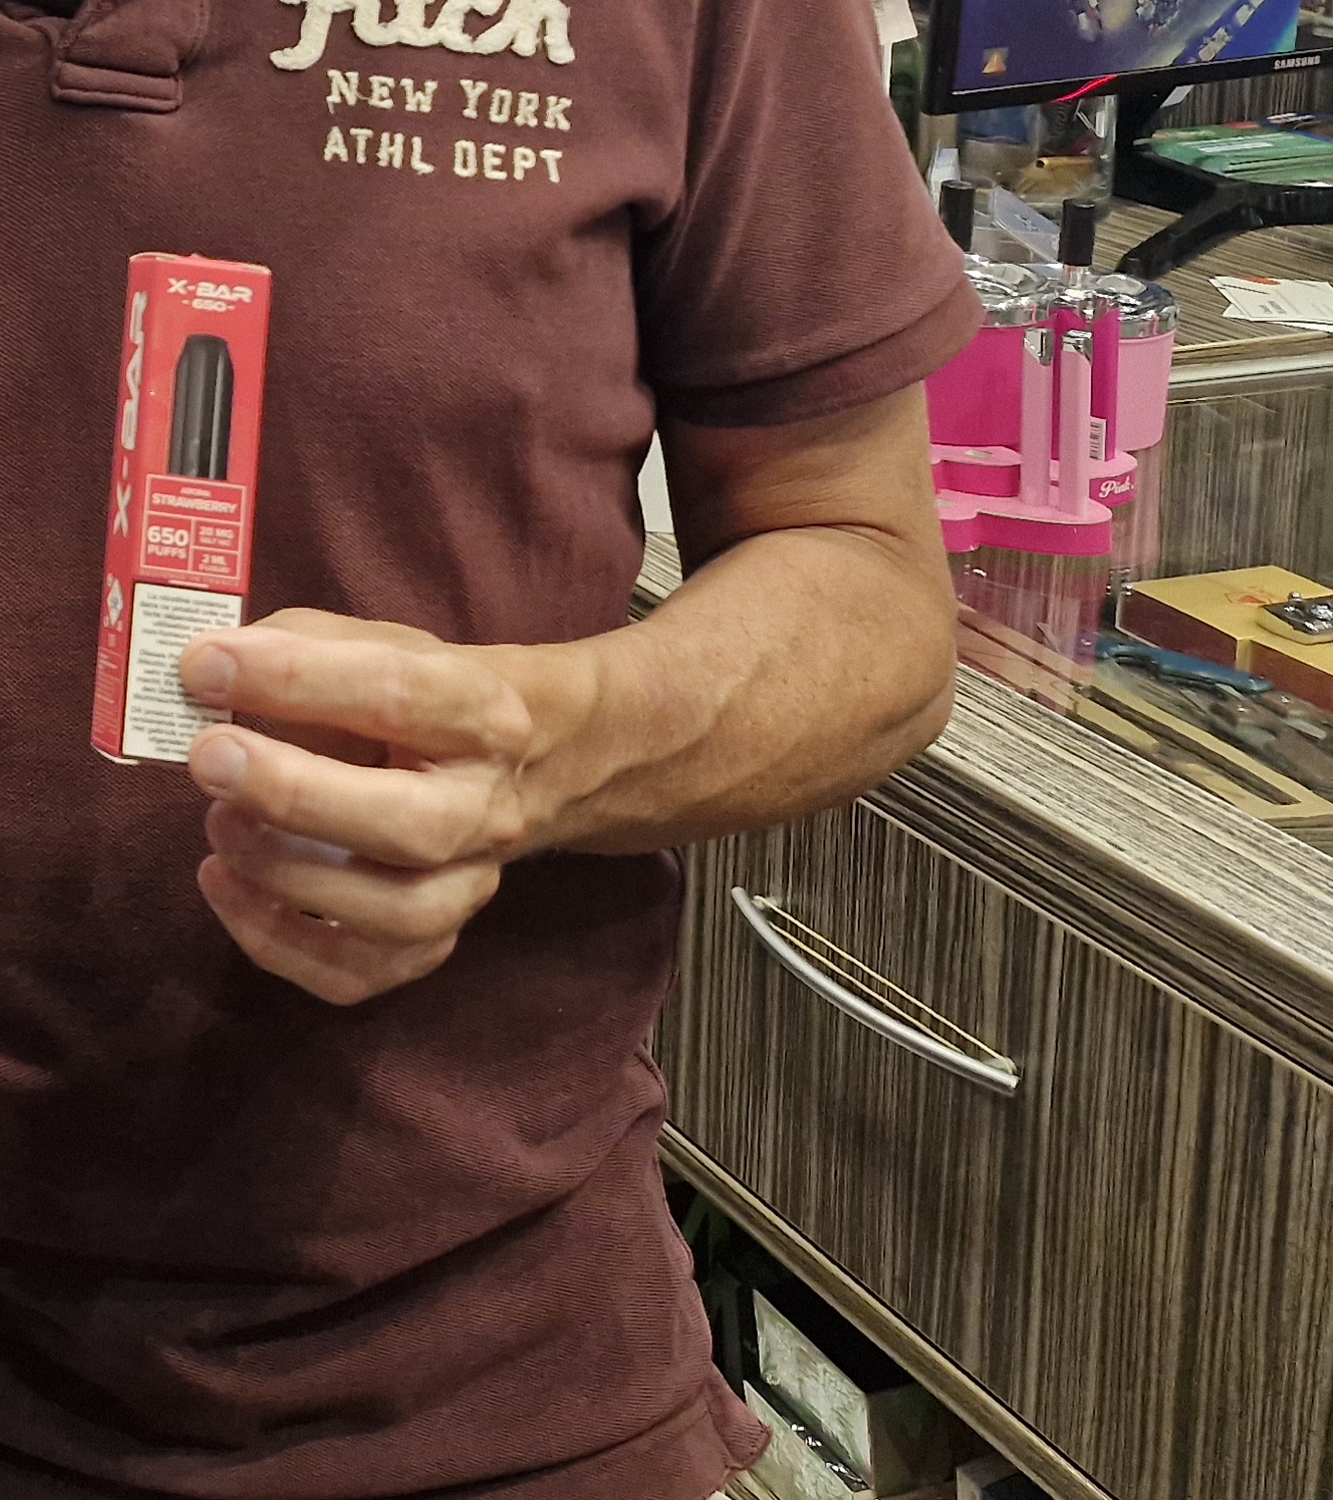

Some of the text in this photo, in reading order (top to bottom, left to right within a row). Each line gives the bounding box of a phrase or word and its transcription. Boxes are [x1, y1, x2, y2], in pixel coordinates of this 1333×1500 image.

[1273, 55, 1322, 71] SAMSUNG
[326, 69, 573, 131] NEW YORK
[323, 126, 563, 183] ATHL DEPT
[167, 277, 254, 304] X-BAR
[151, 492, 238, 515] STRAWBERRY
[146, 525, 189, 548] 650
[147, 544, 188, 560] PUFFS
